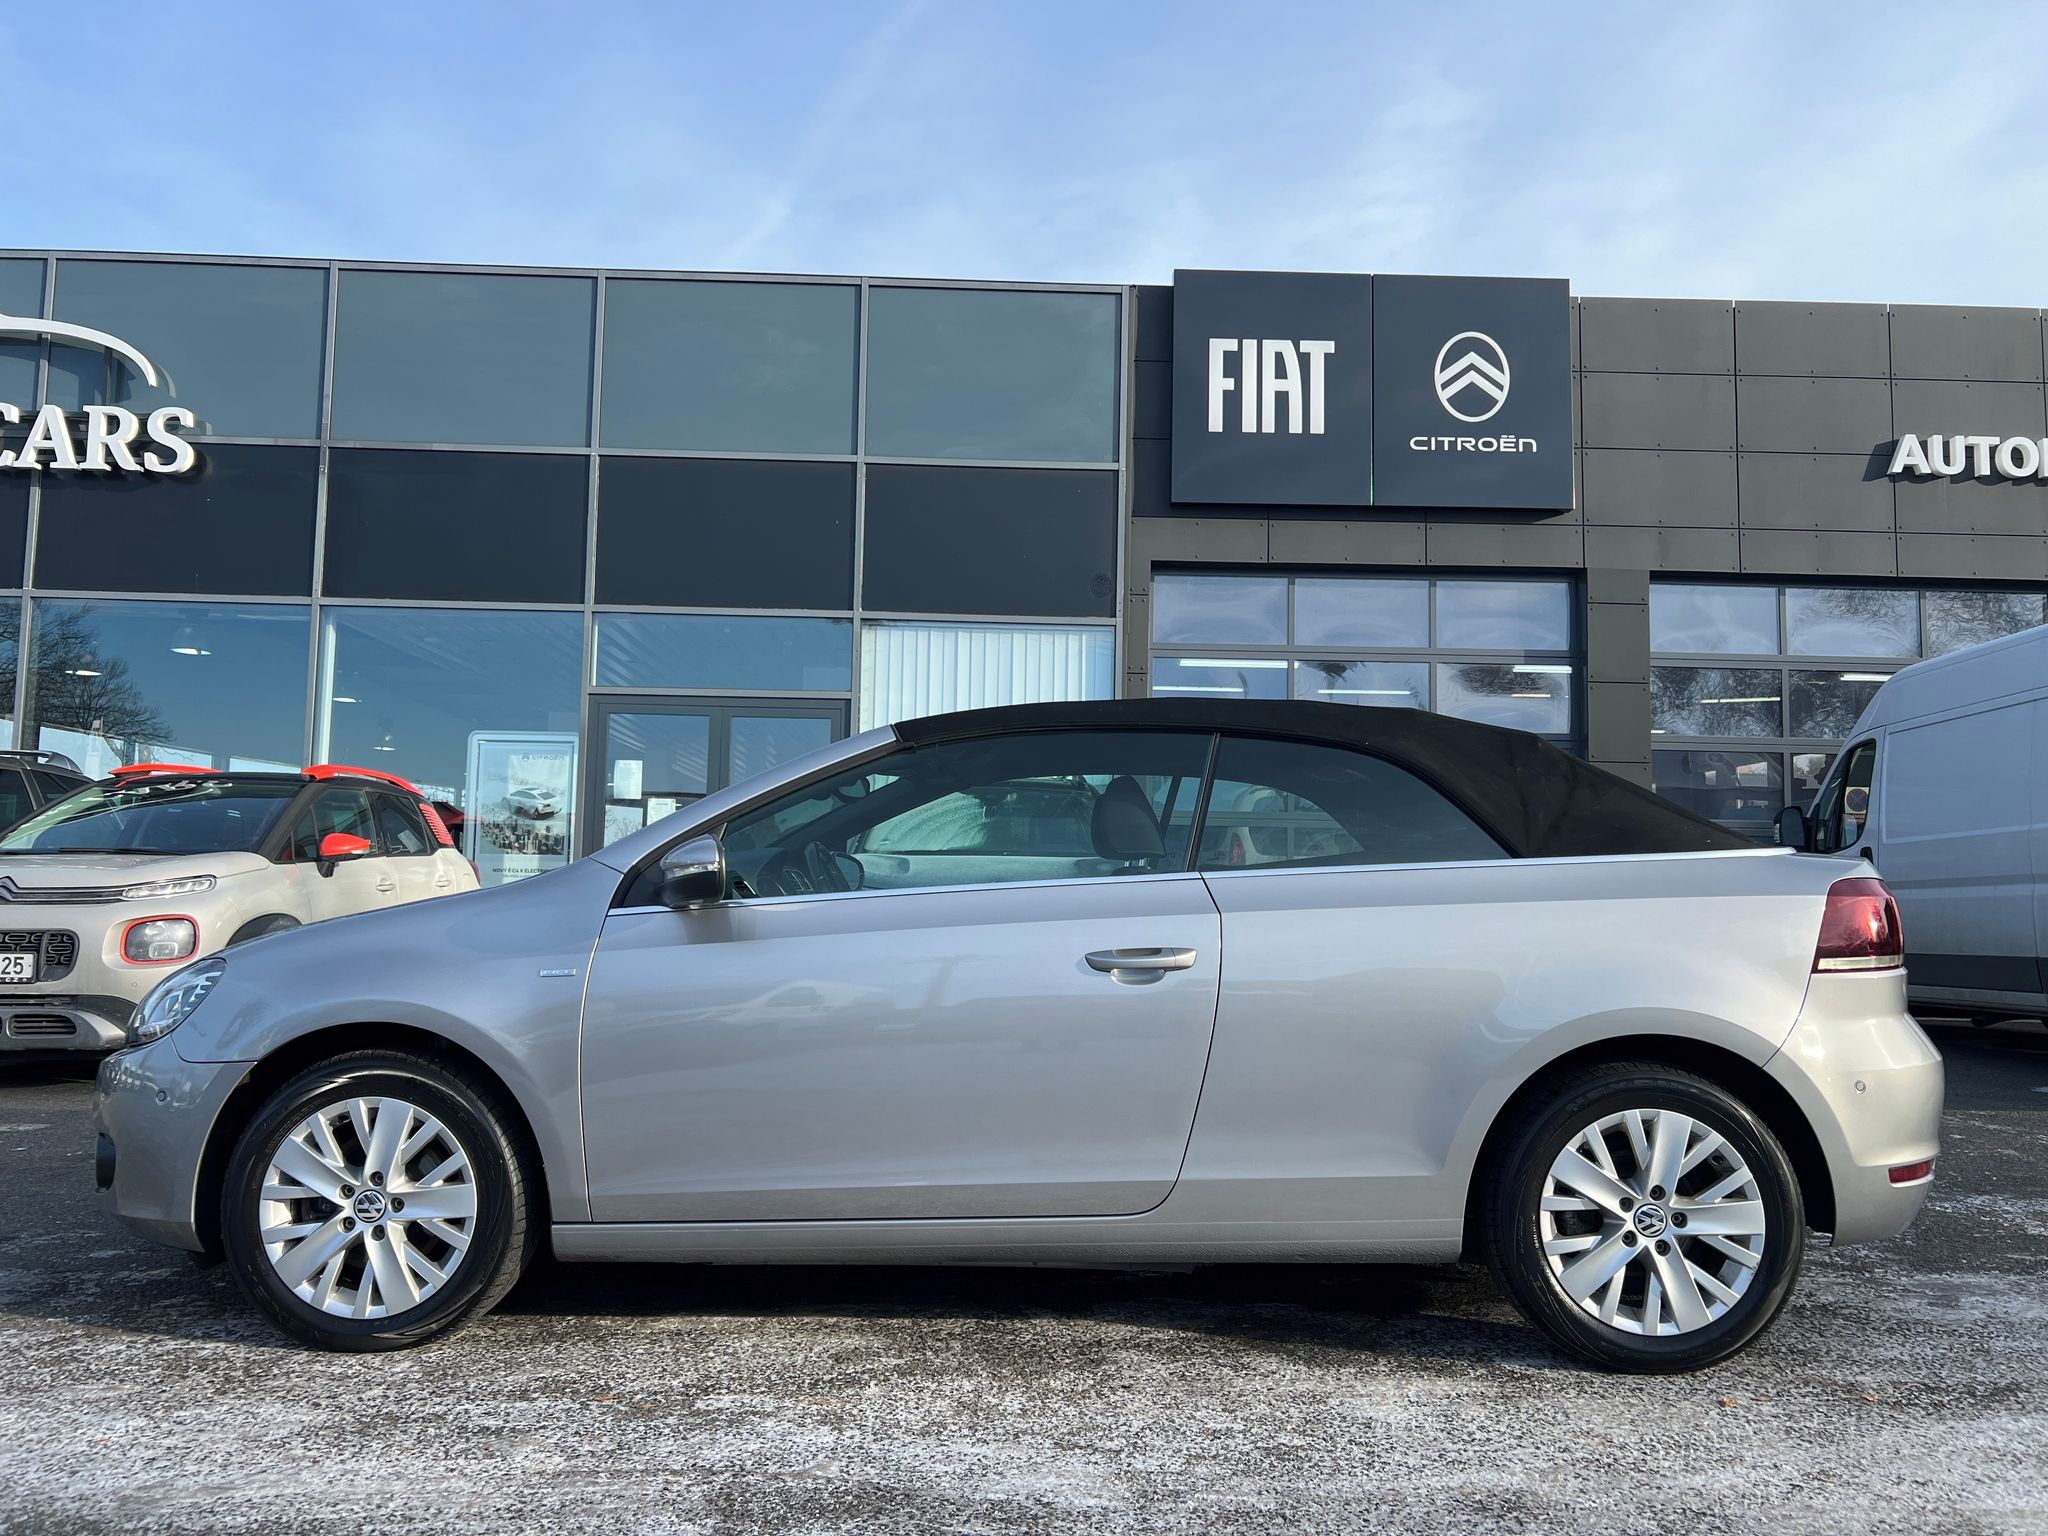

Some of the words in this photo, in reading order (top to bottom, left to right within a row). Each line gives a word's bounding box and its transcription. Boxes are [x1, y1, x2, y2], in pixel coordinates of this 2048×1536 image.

[1208, 338, 1335, 435] FIAT
[1887, 433, 2048, 479] AUTO
[1, 956, 25, 975] 25
